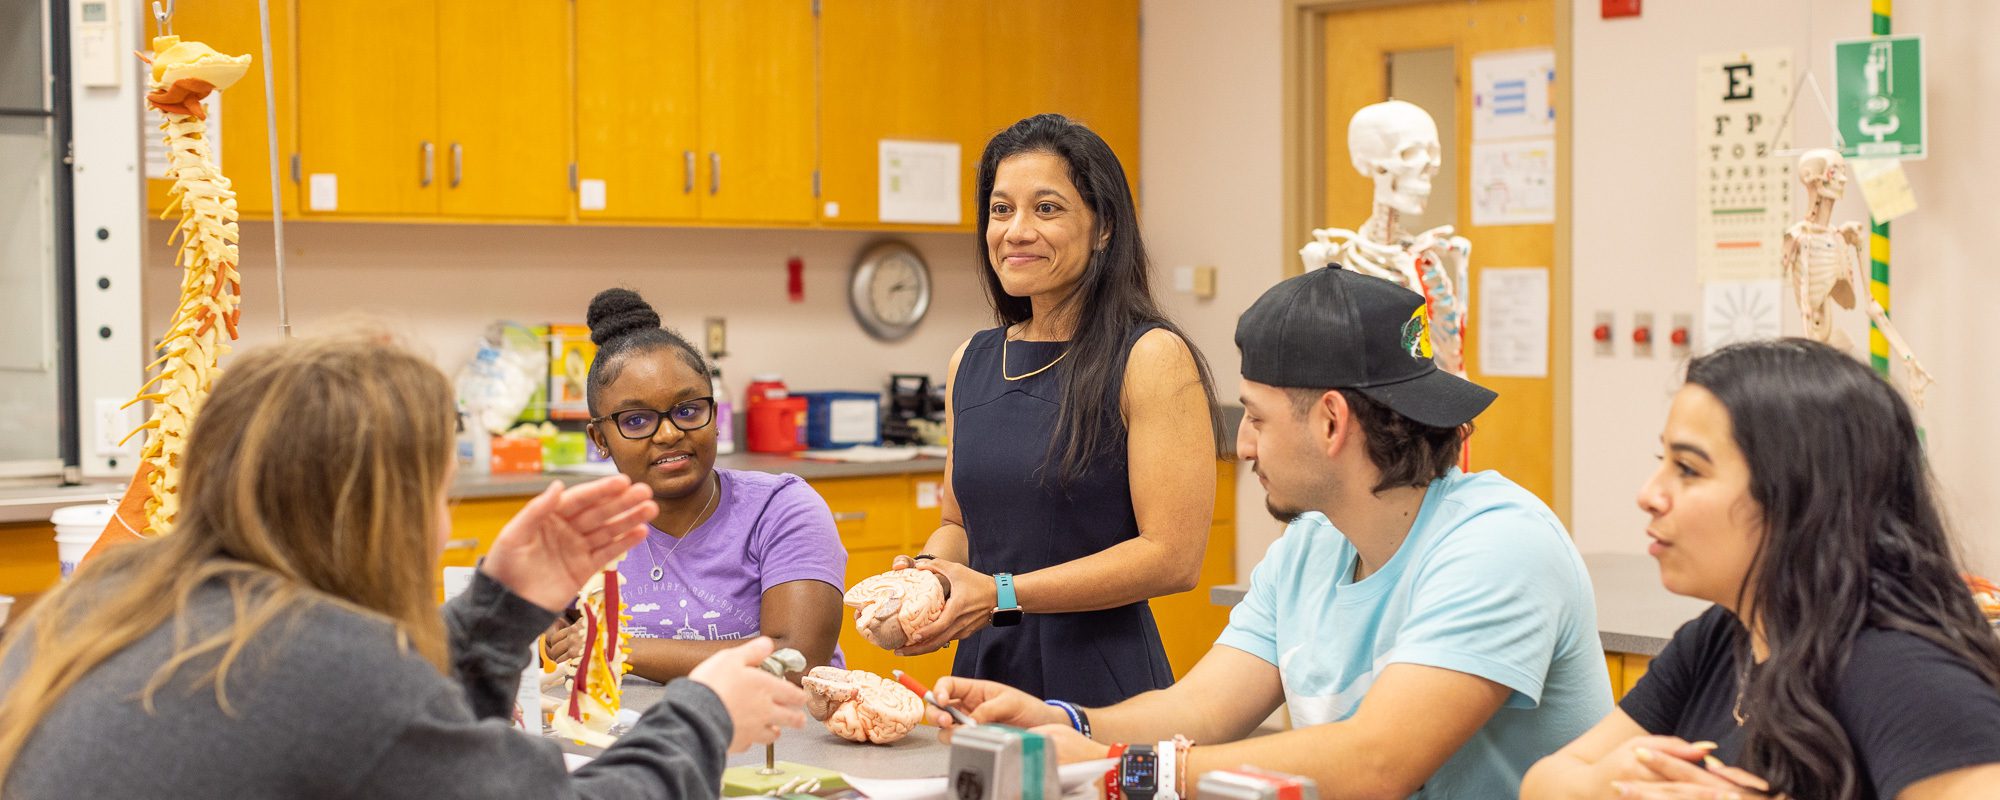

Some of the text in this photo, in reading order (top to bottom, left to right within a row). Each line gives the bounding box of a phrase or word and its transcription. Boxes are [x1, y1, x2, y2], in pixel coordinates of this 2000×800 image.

[1723, 63, 1753, 102] E
[1746, 113, 1762, 134] P
[1731, 143, 1745, 160] O
[637, 581, 758, 630] OF MARY RDIN-BAYLOR
